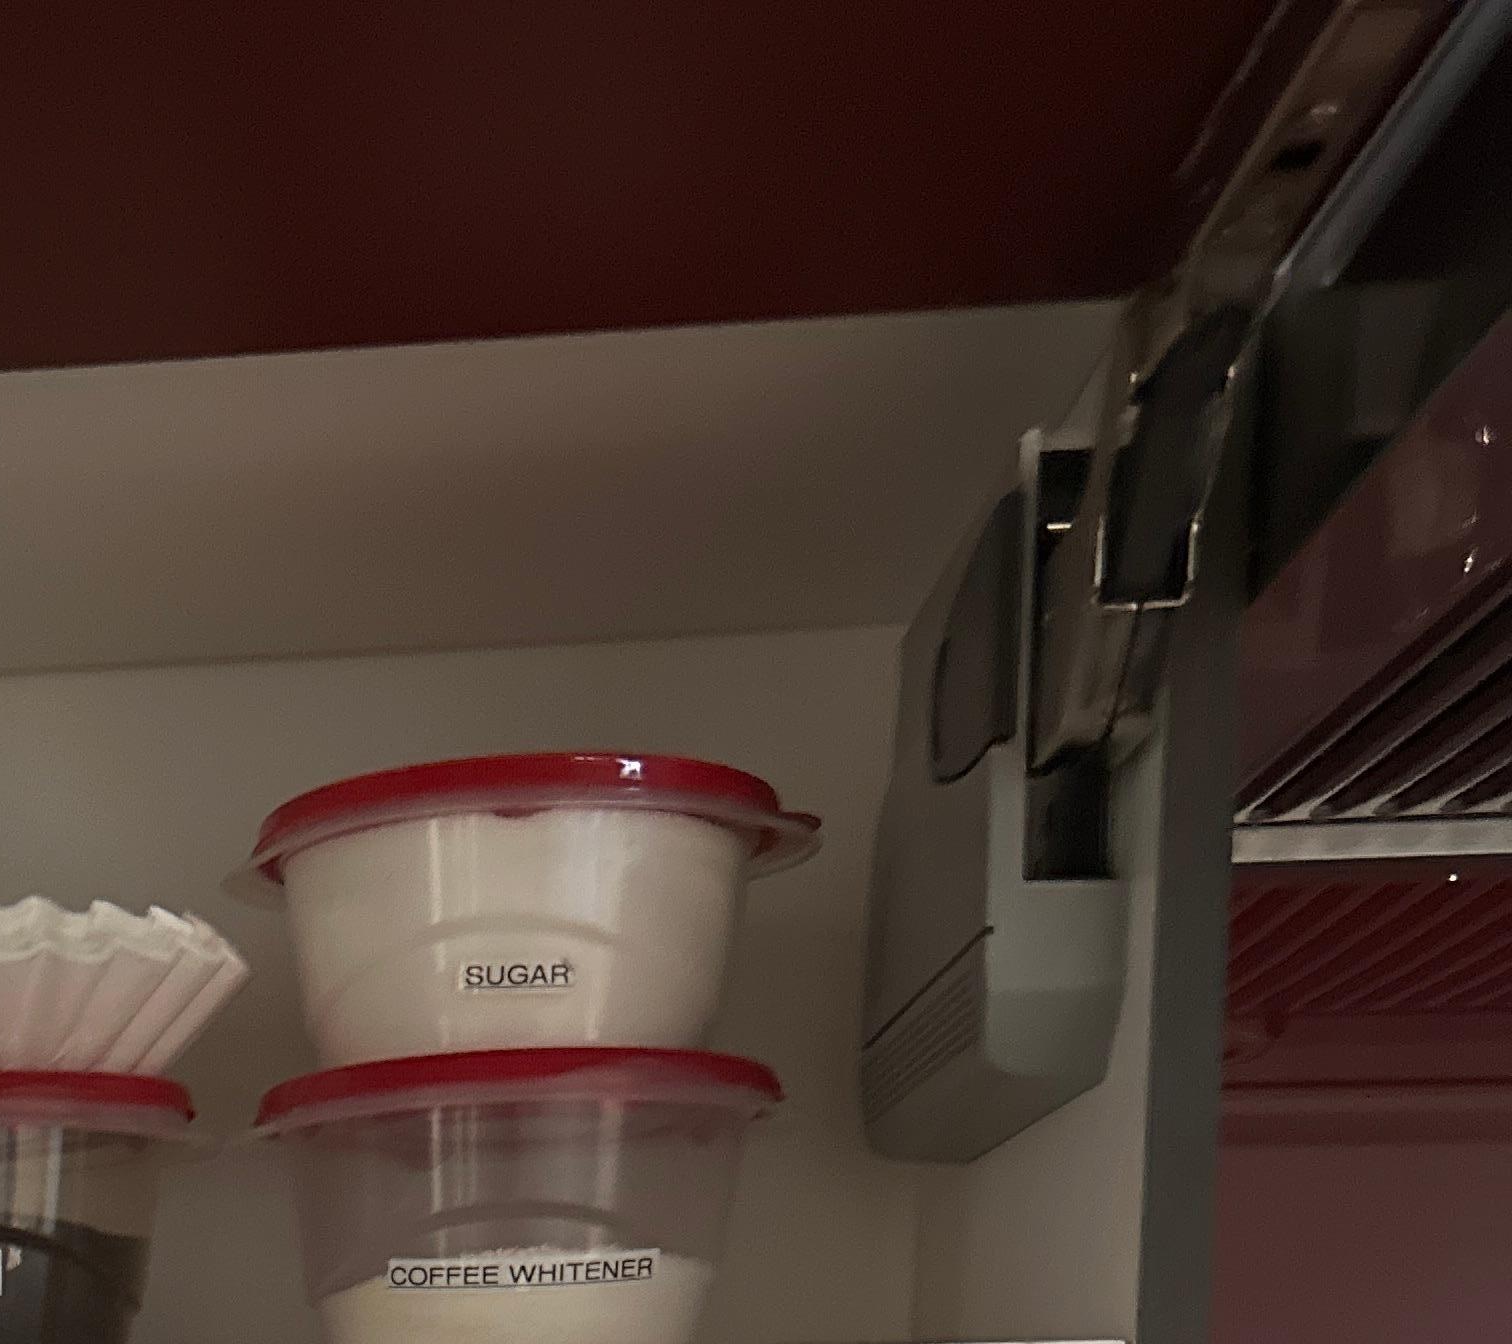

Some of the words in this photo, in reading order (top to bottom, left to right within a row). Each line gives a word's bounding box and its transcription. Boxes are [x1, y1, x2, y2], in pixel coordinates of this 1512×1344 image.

[465, 964, 570, 985] SUGAR
[389, 1265, 499, 1285] COFFEE
[508, 1257, 652, 1284] WHITENER
